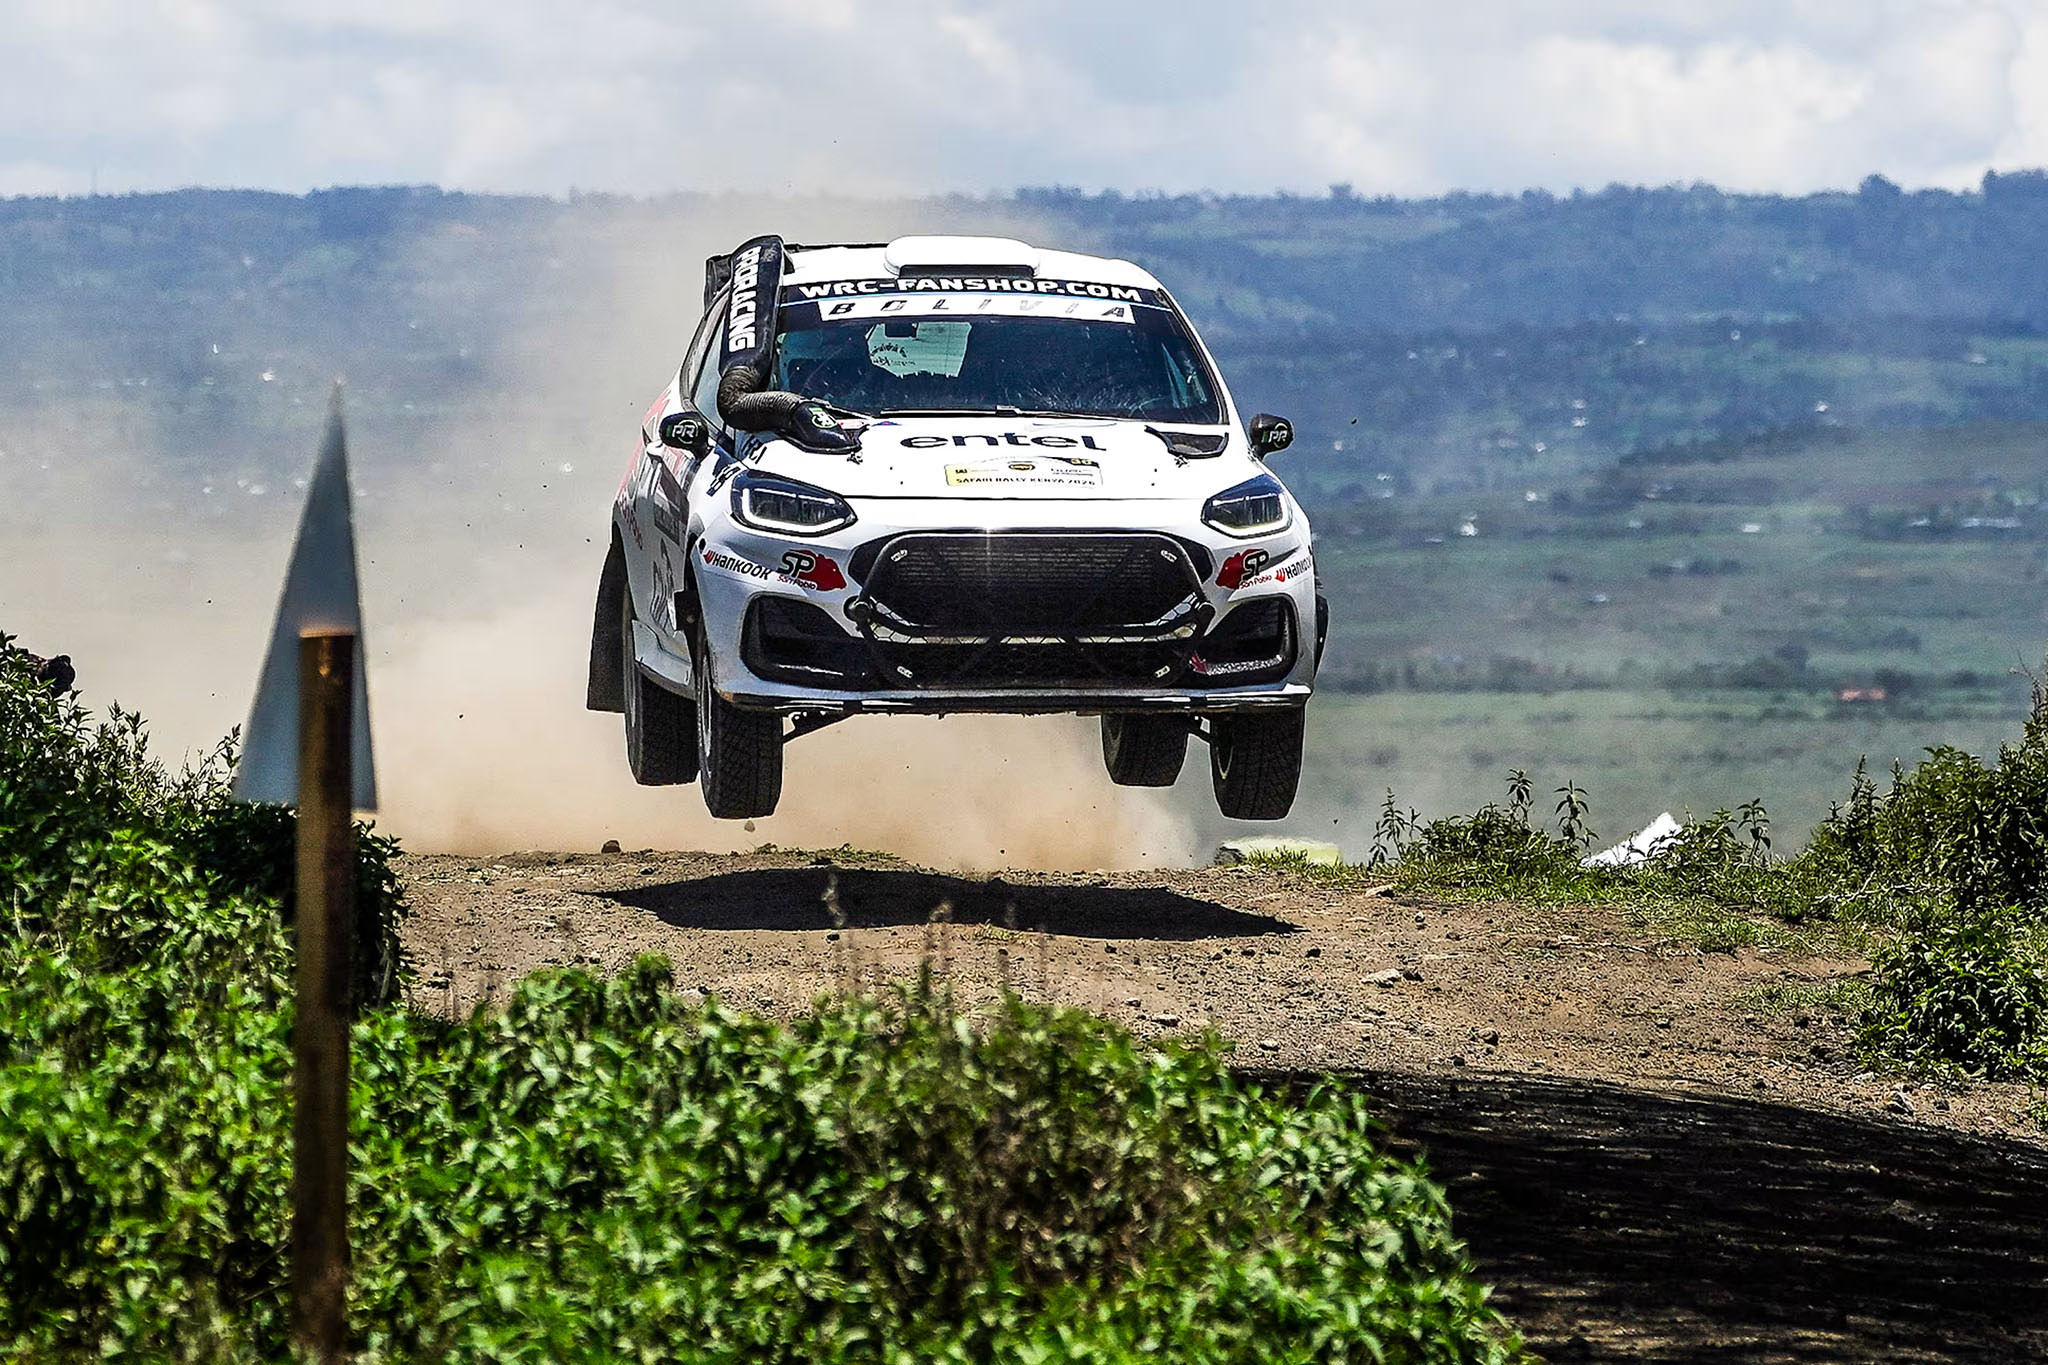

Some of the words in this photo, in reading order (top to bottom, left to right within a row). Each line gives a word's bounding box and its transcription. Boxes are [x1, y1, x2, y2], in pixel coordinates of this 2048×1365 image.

[728, 246, 762, 353] PRORACING
[799, 277, 1143, 303] WRC-FANSHOP.COM
[828, 299, 1126, 318] BOLIVIA
[900, 432, 1107, 452] entel
[995, 476, 1027, 484] RALLY
[1030, 477, 1064, 485] KENYA
[776, 551, 816, 578] SP
